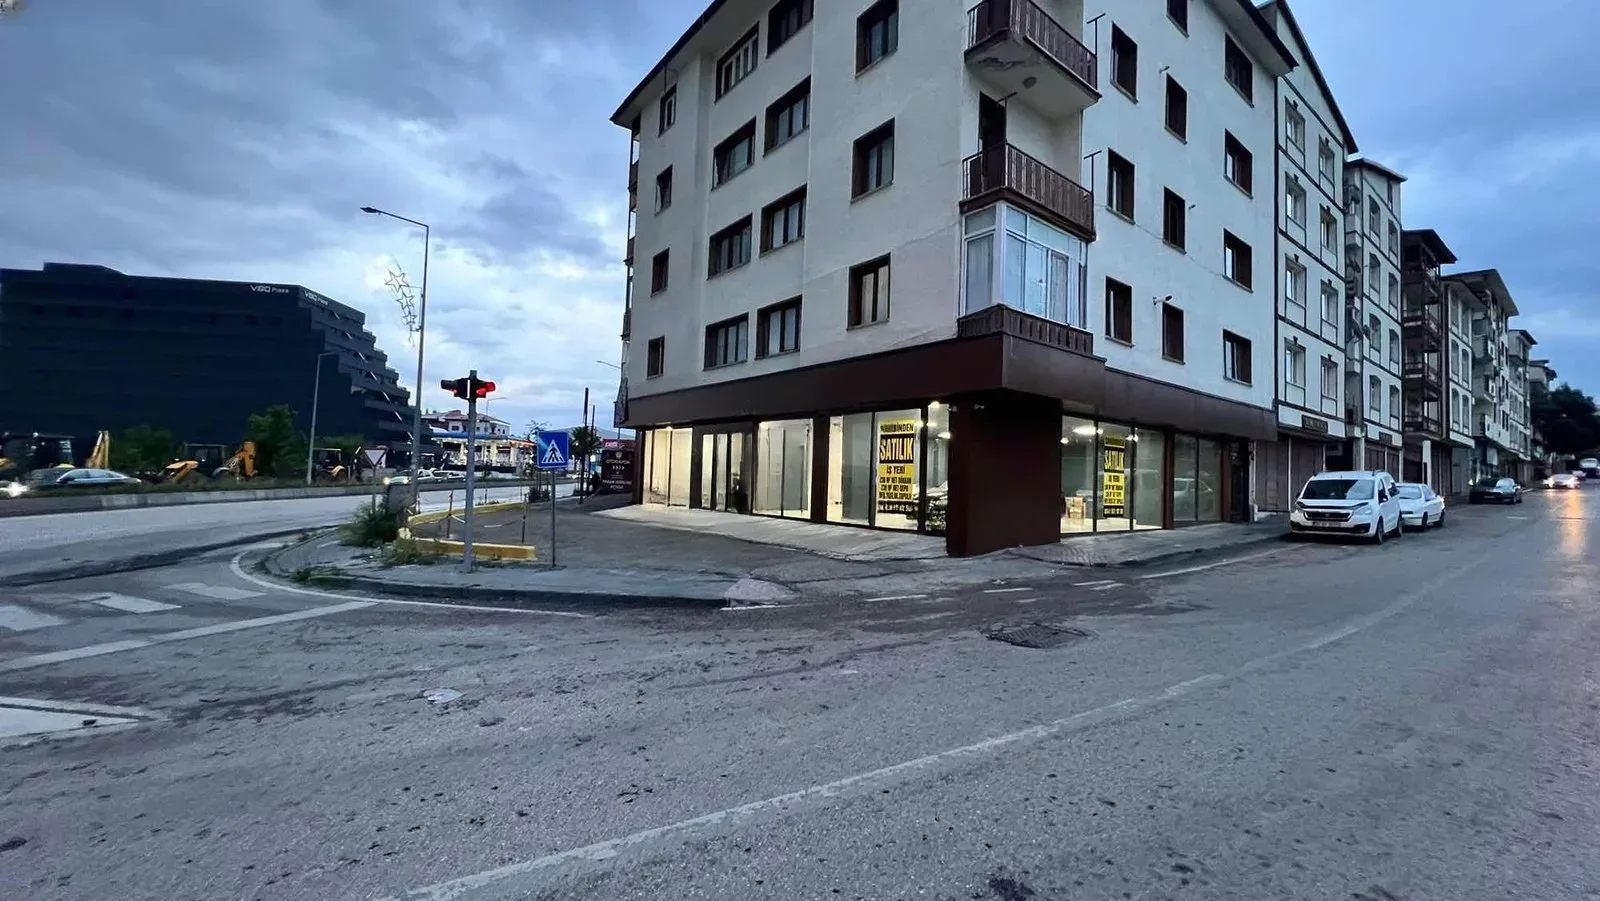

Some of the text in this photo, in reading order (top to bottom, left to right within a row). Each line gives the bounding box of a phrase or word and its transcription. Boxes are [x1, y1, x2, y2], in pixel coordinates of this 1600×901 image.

[880, 438, 913, 461] SATILIK
[886, 464, 906, 475] İŞ YERİ
[1104, 450, 1124, 470] SATILIK
